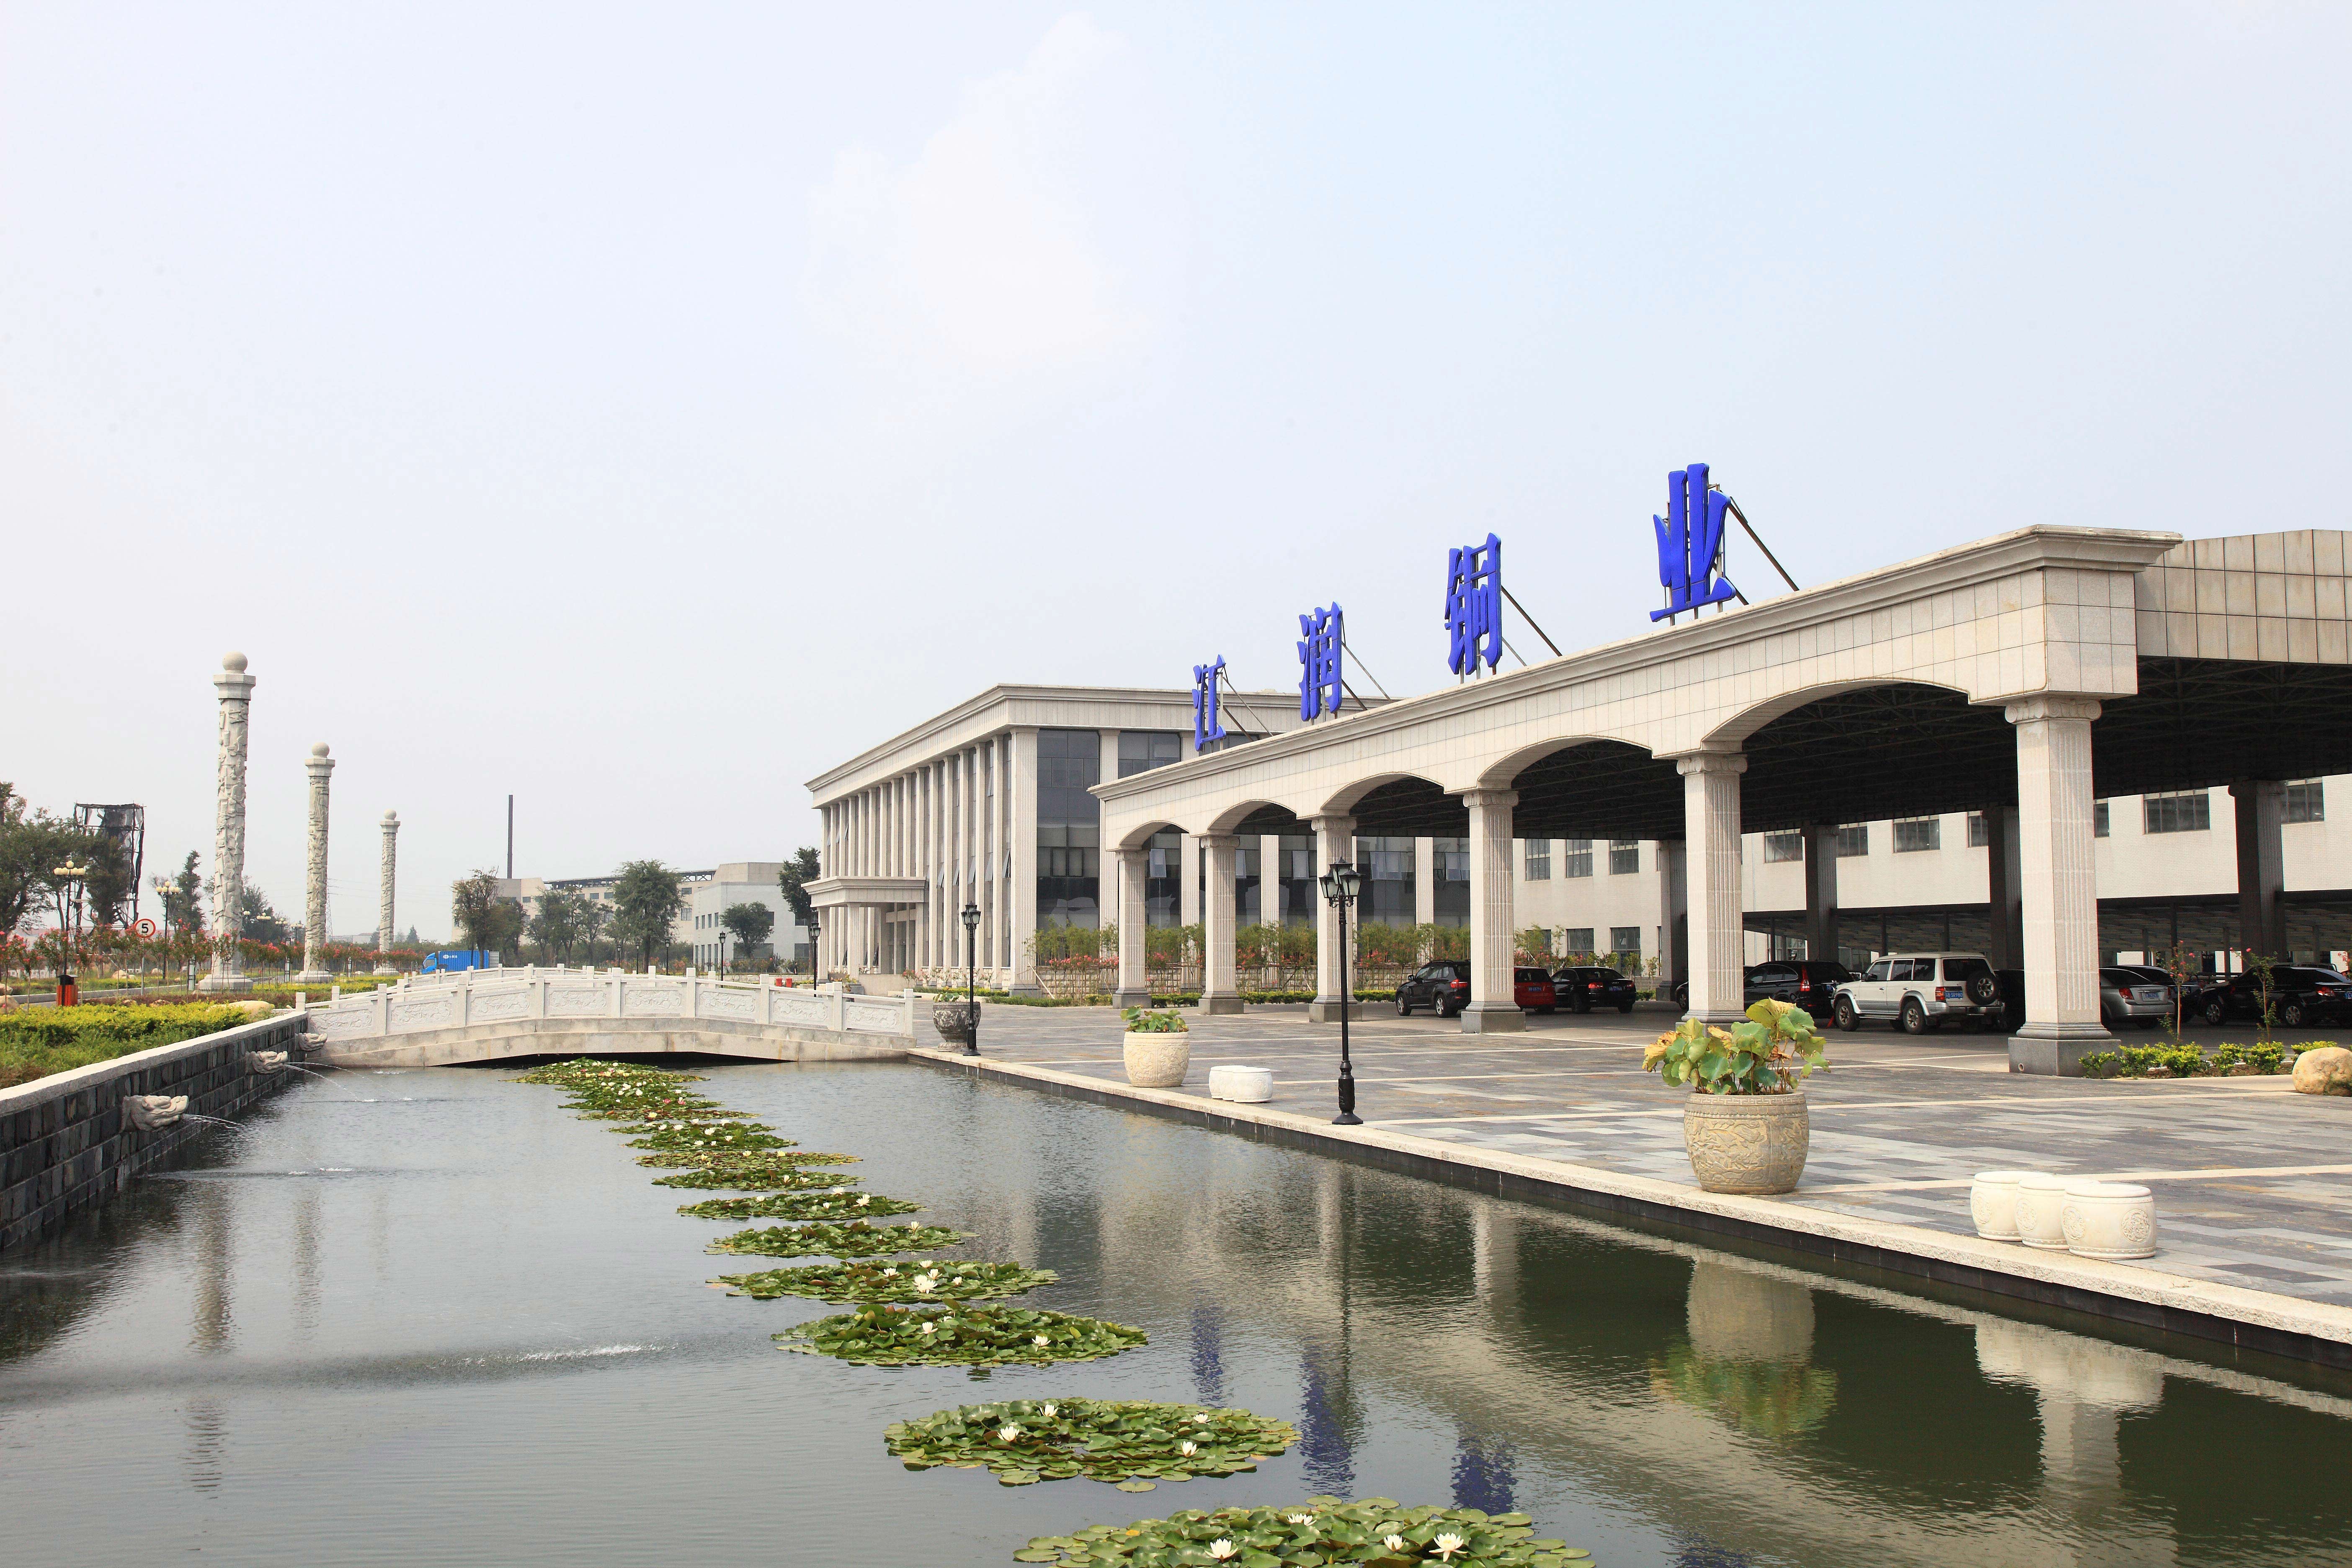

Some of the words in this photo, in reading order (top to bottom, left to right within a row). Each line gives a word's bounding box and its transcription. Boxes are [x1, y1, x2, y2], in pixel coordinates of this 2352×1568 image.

[1192, 463, 1736, 752] 江润铜业
[142, 923, 149, 934] 5
